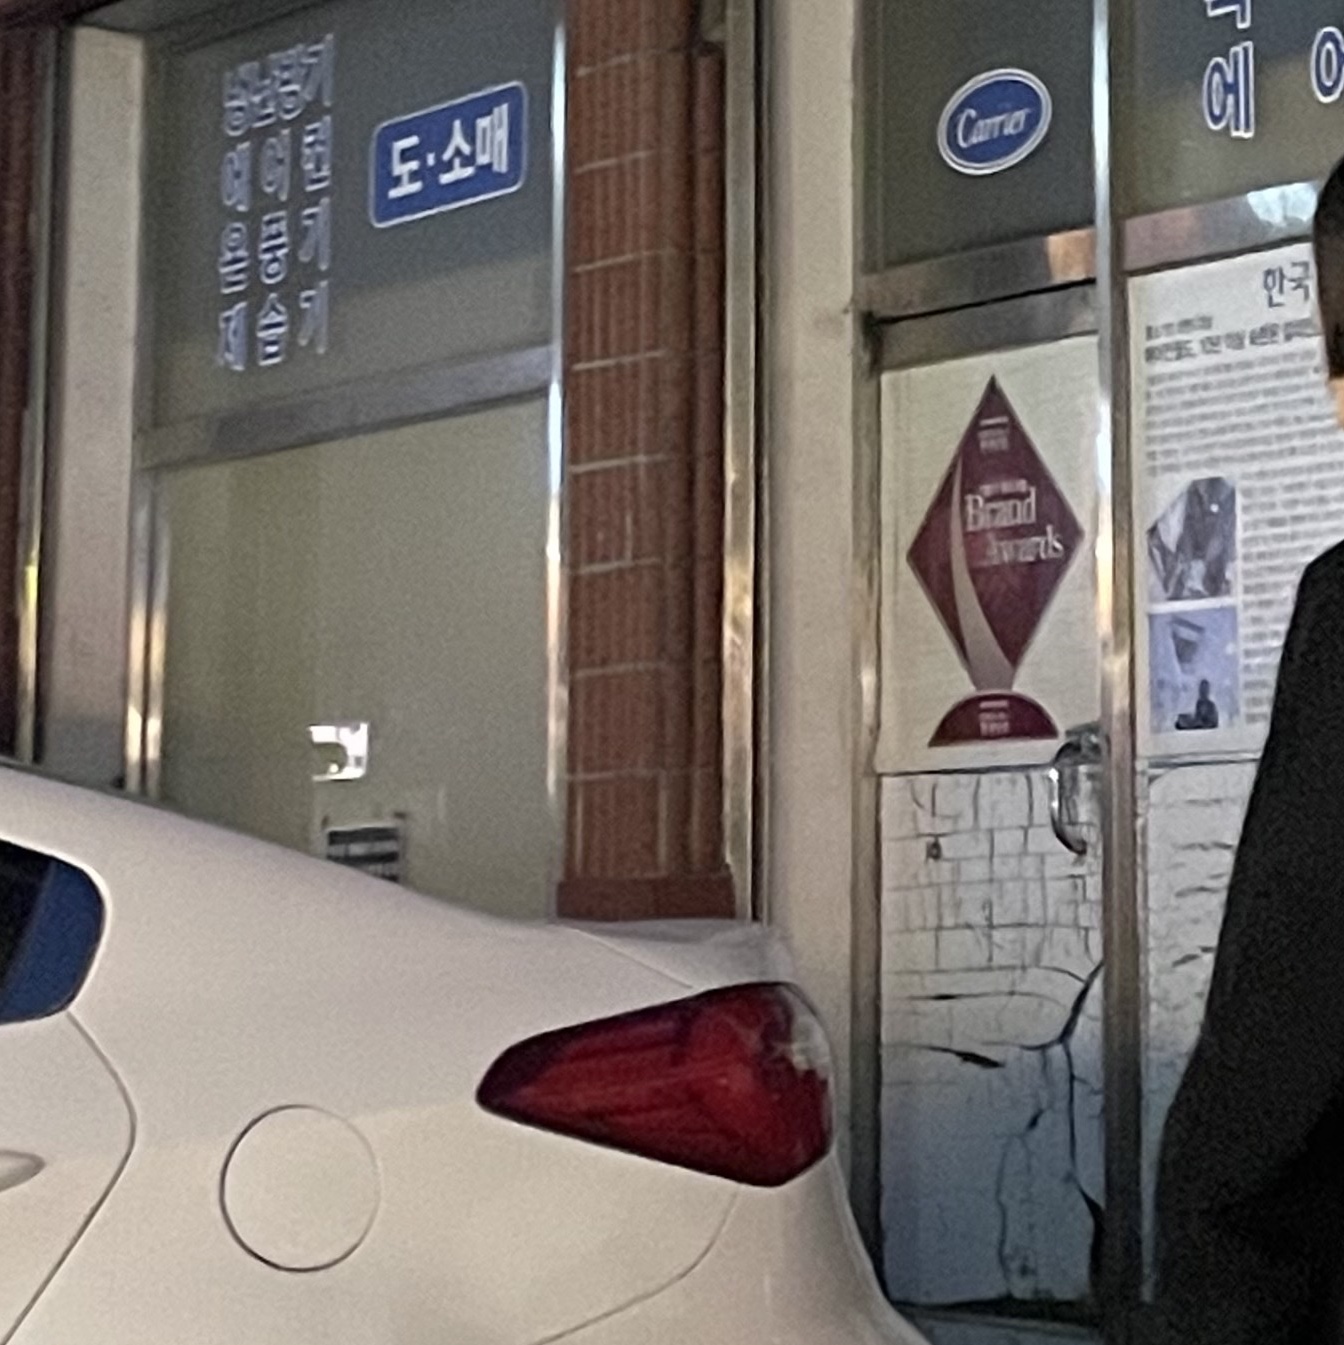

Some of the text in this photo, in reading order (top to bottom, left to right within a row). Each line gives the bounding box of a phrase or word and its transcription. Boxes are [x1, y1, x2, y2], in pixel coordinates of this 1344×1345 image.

[220, 115, 332, 212] 에어컨
[387, 102, 509, 199] 도·소매
[956, 107, 1032, 149] Carrier
[218, 197, 332, 294] 온풍기
[216, 279, 330, 372] 제습기
[963, 485, 1037, 533] Brand
